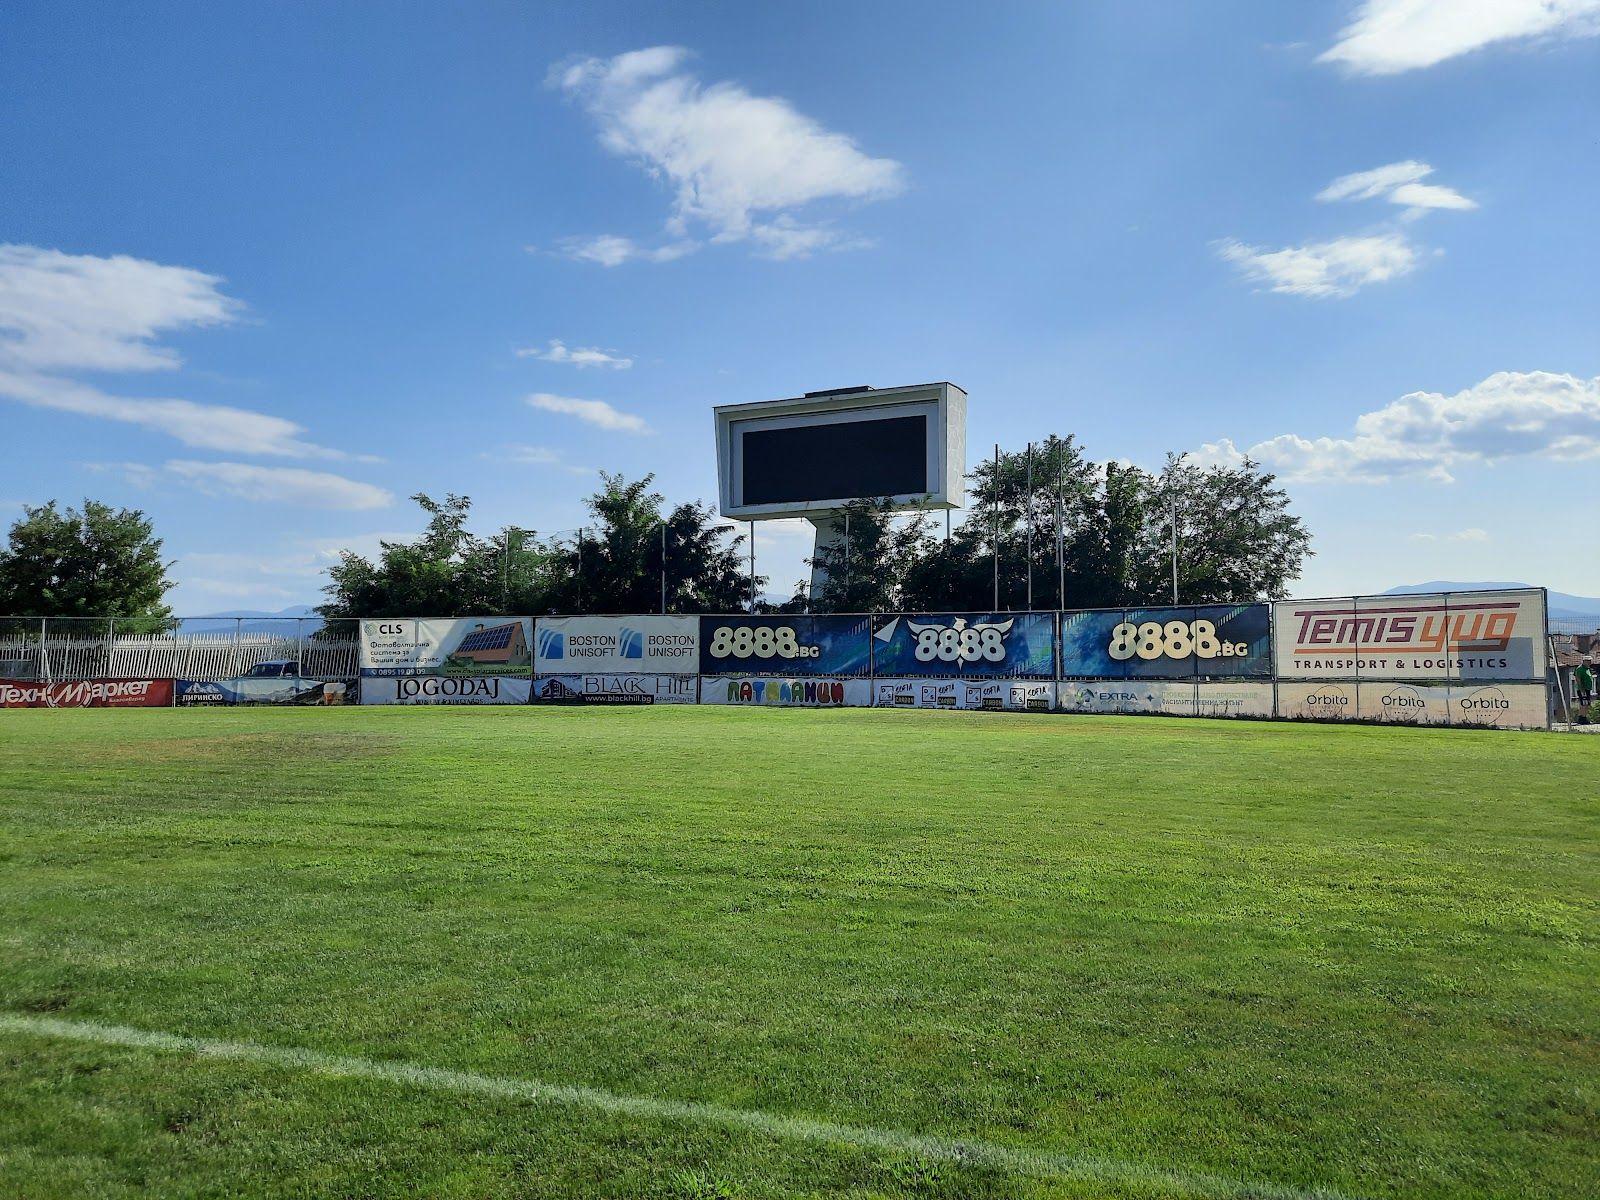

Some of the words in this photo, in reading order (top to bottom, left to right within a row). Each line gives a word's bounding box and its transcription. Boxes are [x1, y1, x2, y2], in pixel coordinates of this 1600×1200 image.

[379, 624, 403, 635] CLS
[569, 635, 616, 646] BOSTON
[648, 635, 695, 646] BOSTON
[914, 628, 1006, 662] 8888
[569, 647, 616, 657] UNISOFT
[648, 647, 695, 657] UNISOFT
[1294, 659, 1388, 669] TRANSPORT
[1395, 659, 1405, 669] &
[1413, 658, 1508, 669] LOGISTICS
[378, 668, 396, 676] 0895
[396, 678, 500, 700] LOGODAJ
[585, 677, 646, 694] BLACK
[656, 677, 694, 695] HILL
[182, 694, 224, 702] ПИРИНСКО
[585, 694, 652, 704] www.blackhill.bg
[1099, 692, 1138, 700] EXTRA
[1306, 694, 1348, 705] Orbita
[1381, 695, 1425, 707] Orbita
[1460, 697, 1509, 709] Orbita
